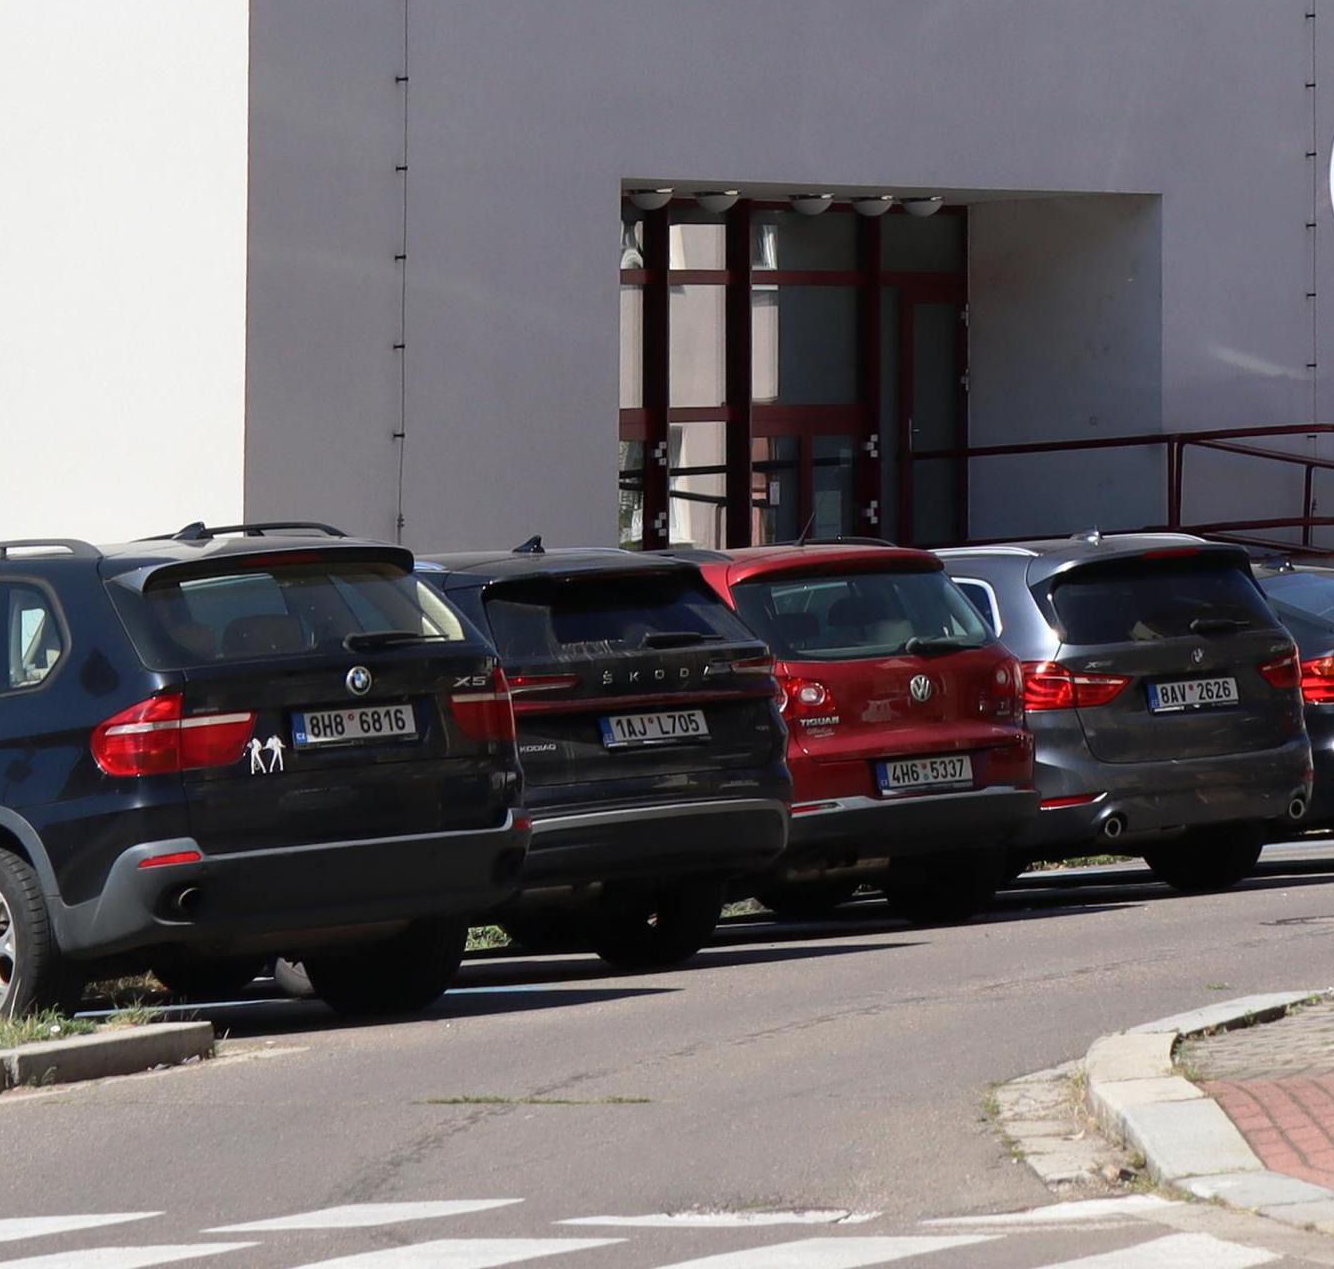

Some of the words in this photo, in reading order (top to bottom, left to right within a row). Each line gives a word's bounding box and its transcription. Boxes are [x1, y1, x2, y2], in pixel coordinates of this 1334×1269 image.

[453, 675, 487, 687] X5
[1160, 683, 1186, 704] 8AV
[1196, 680, 1231, 701] 2626
[309, 713, 346, 738] 8H8
[359, 708, 407, 734] 6816
[615, 716, 647, 738] 1AJ
[656, 713, 700, 736] L705
[891, 763, 920, 784] 4H6
[930, 758, 965, 780] 5337
